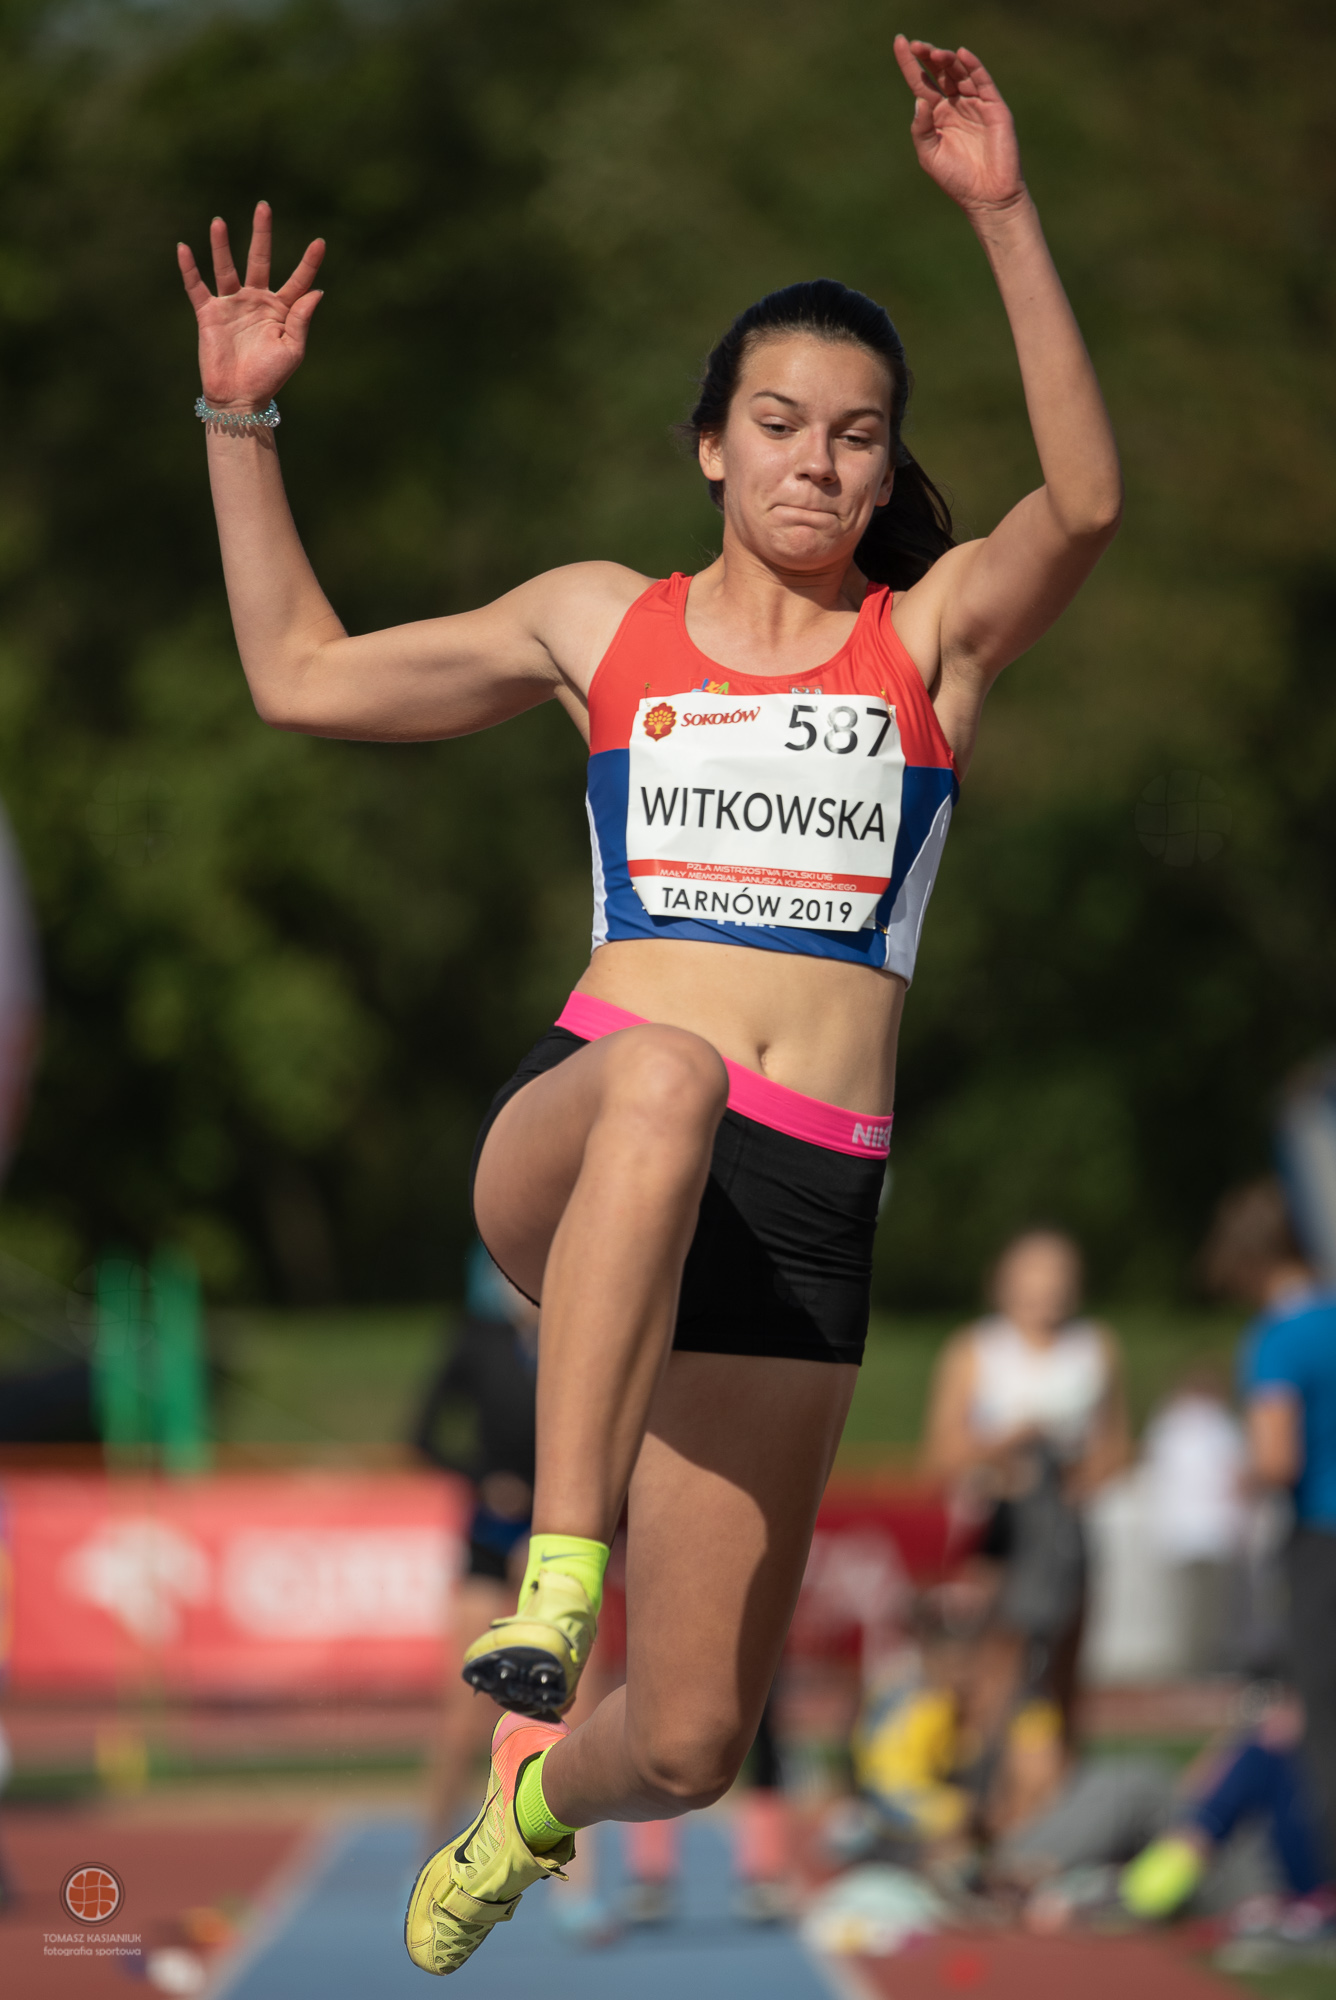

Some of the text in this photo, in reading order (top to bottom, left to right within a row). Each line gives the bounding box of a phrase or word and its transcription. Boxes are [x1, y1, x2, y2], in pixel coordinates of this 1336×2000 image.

[680, 706, 761, 727] SOKOŁÓW
[784, 704, 892, 758] 587
[640, 786, 886, 842] WITKOWSKA
[660, 869, 687, 878] MAŁY
[687, 872, 737, 882] MEMORIAŁ
[739, 876, 784, 886] JANUSZA
[686, 863, 833, 881] PZLA MISTRZOSTWA POLSKI U16
[662, 887, 853, 924] TARNÓW 2019
[852, 1122, 892, 1147] NIK
